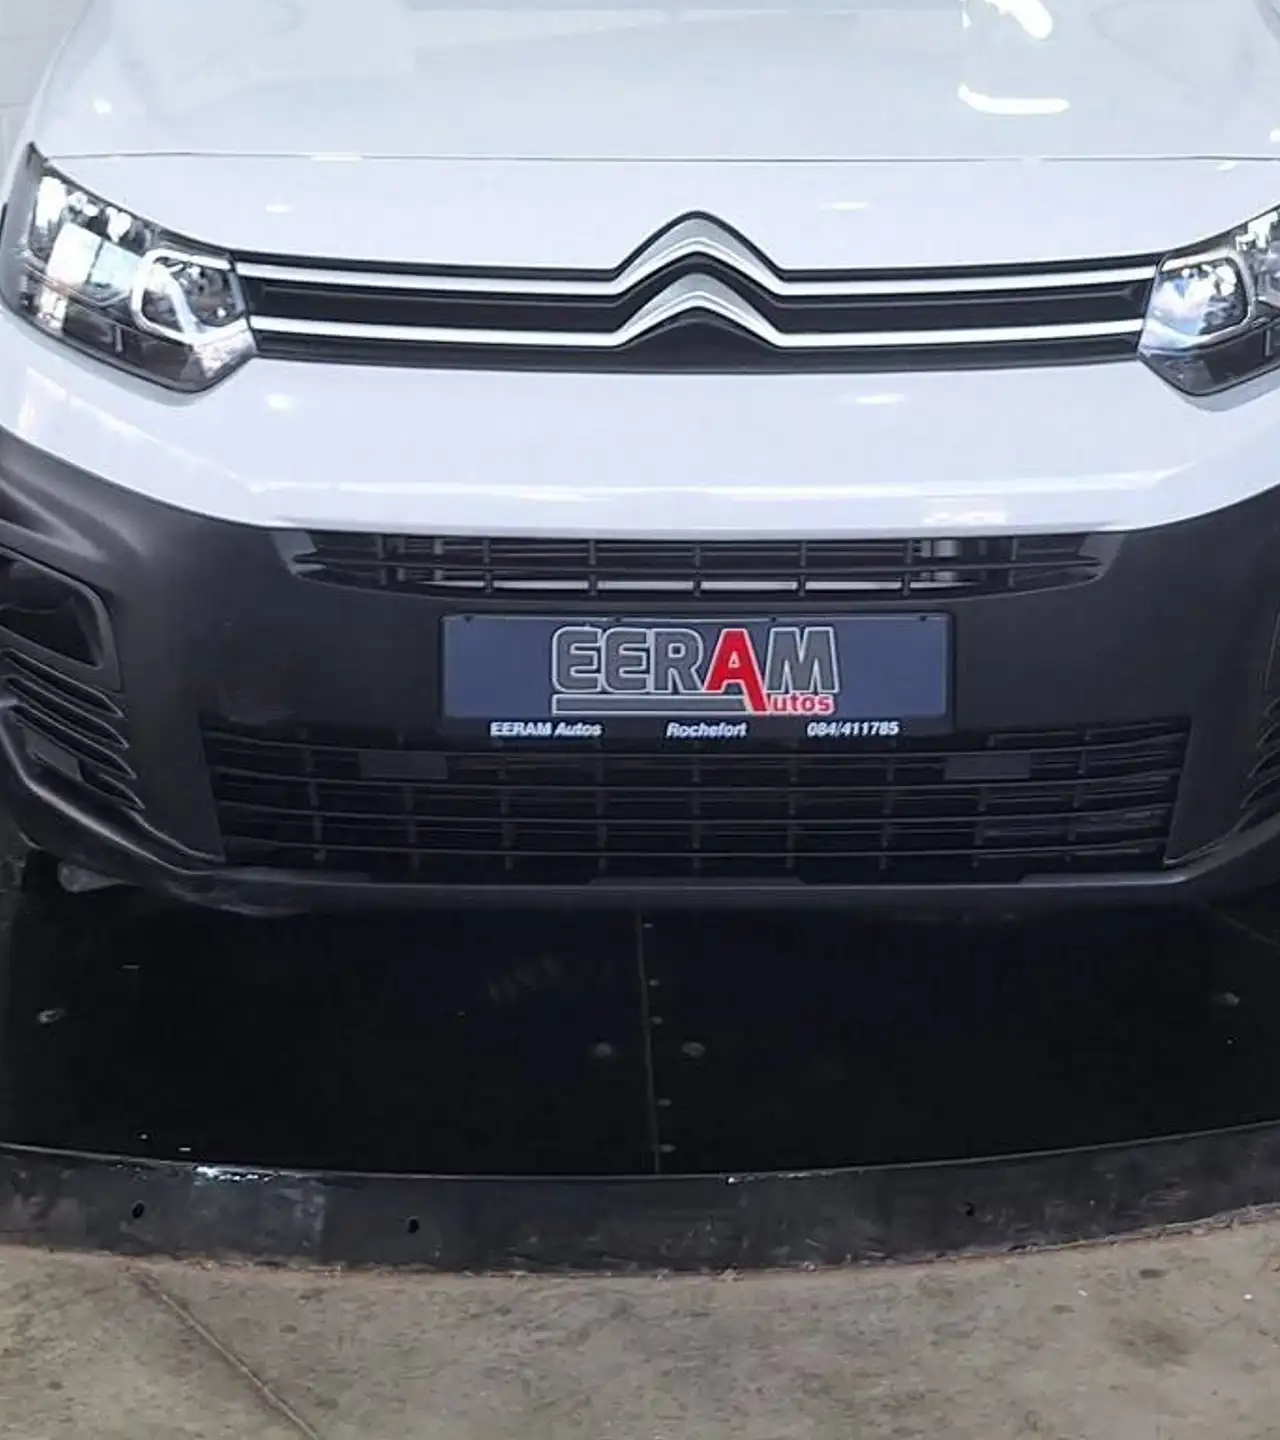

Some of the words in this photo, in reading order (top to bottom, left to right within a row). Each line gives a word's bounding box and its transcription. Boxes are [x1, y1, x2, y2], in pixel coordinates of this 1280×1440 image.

[552, 626, 839, 715] EERAM
[490, 721, 553, 737] EERAM
[553, 721, 603, 738] Autos
[665, 721, 748, 738] Rochefort
[806, 720, 900, 738] 084/411785
